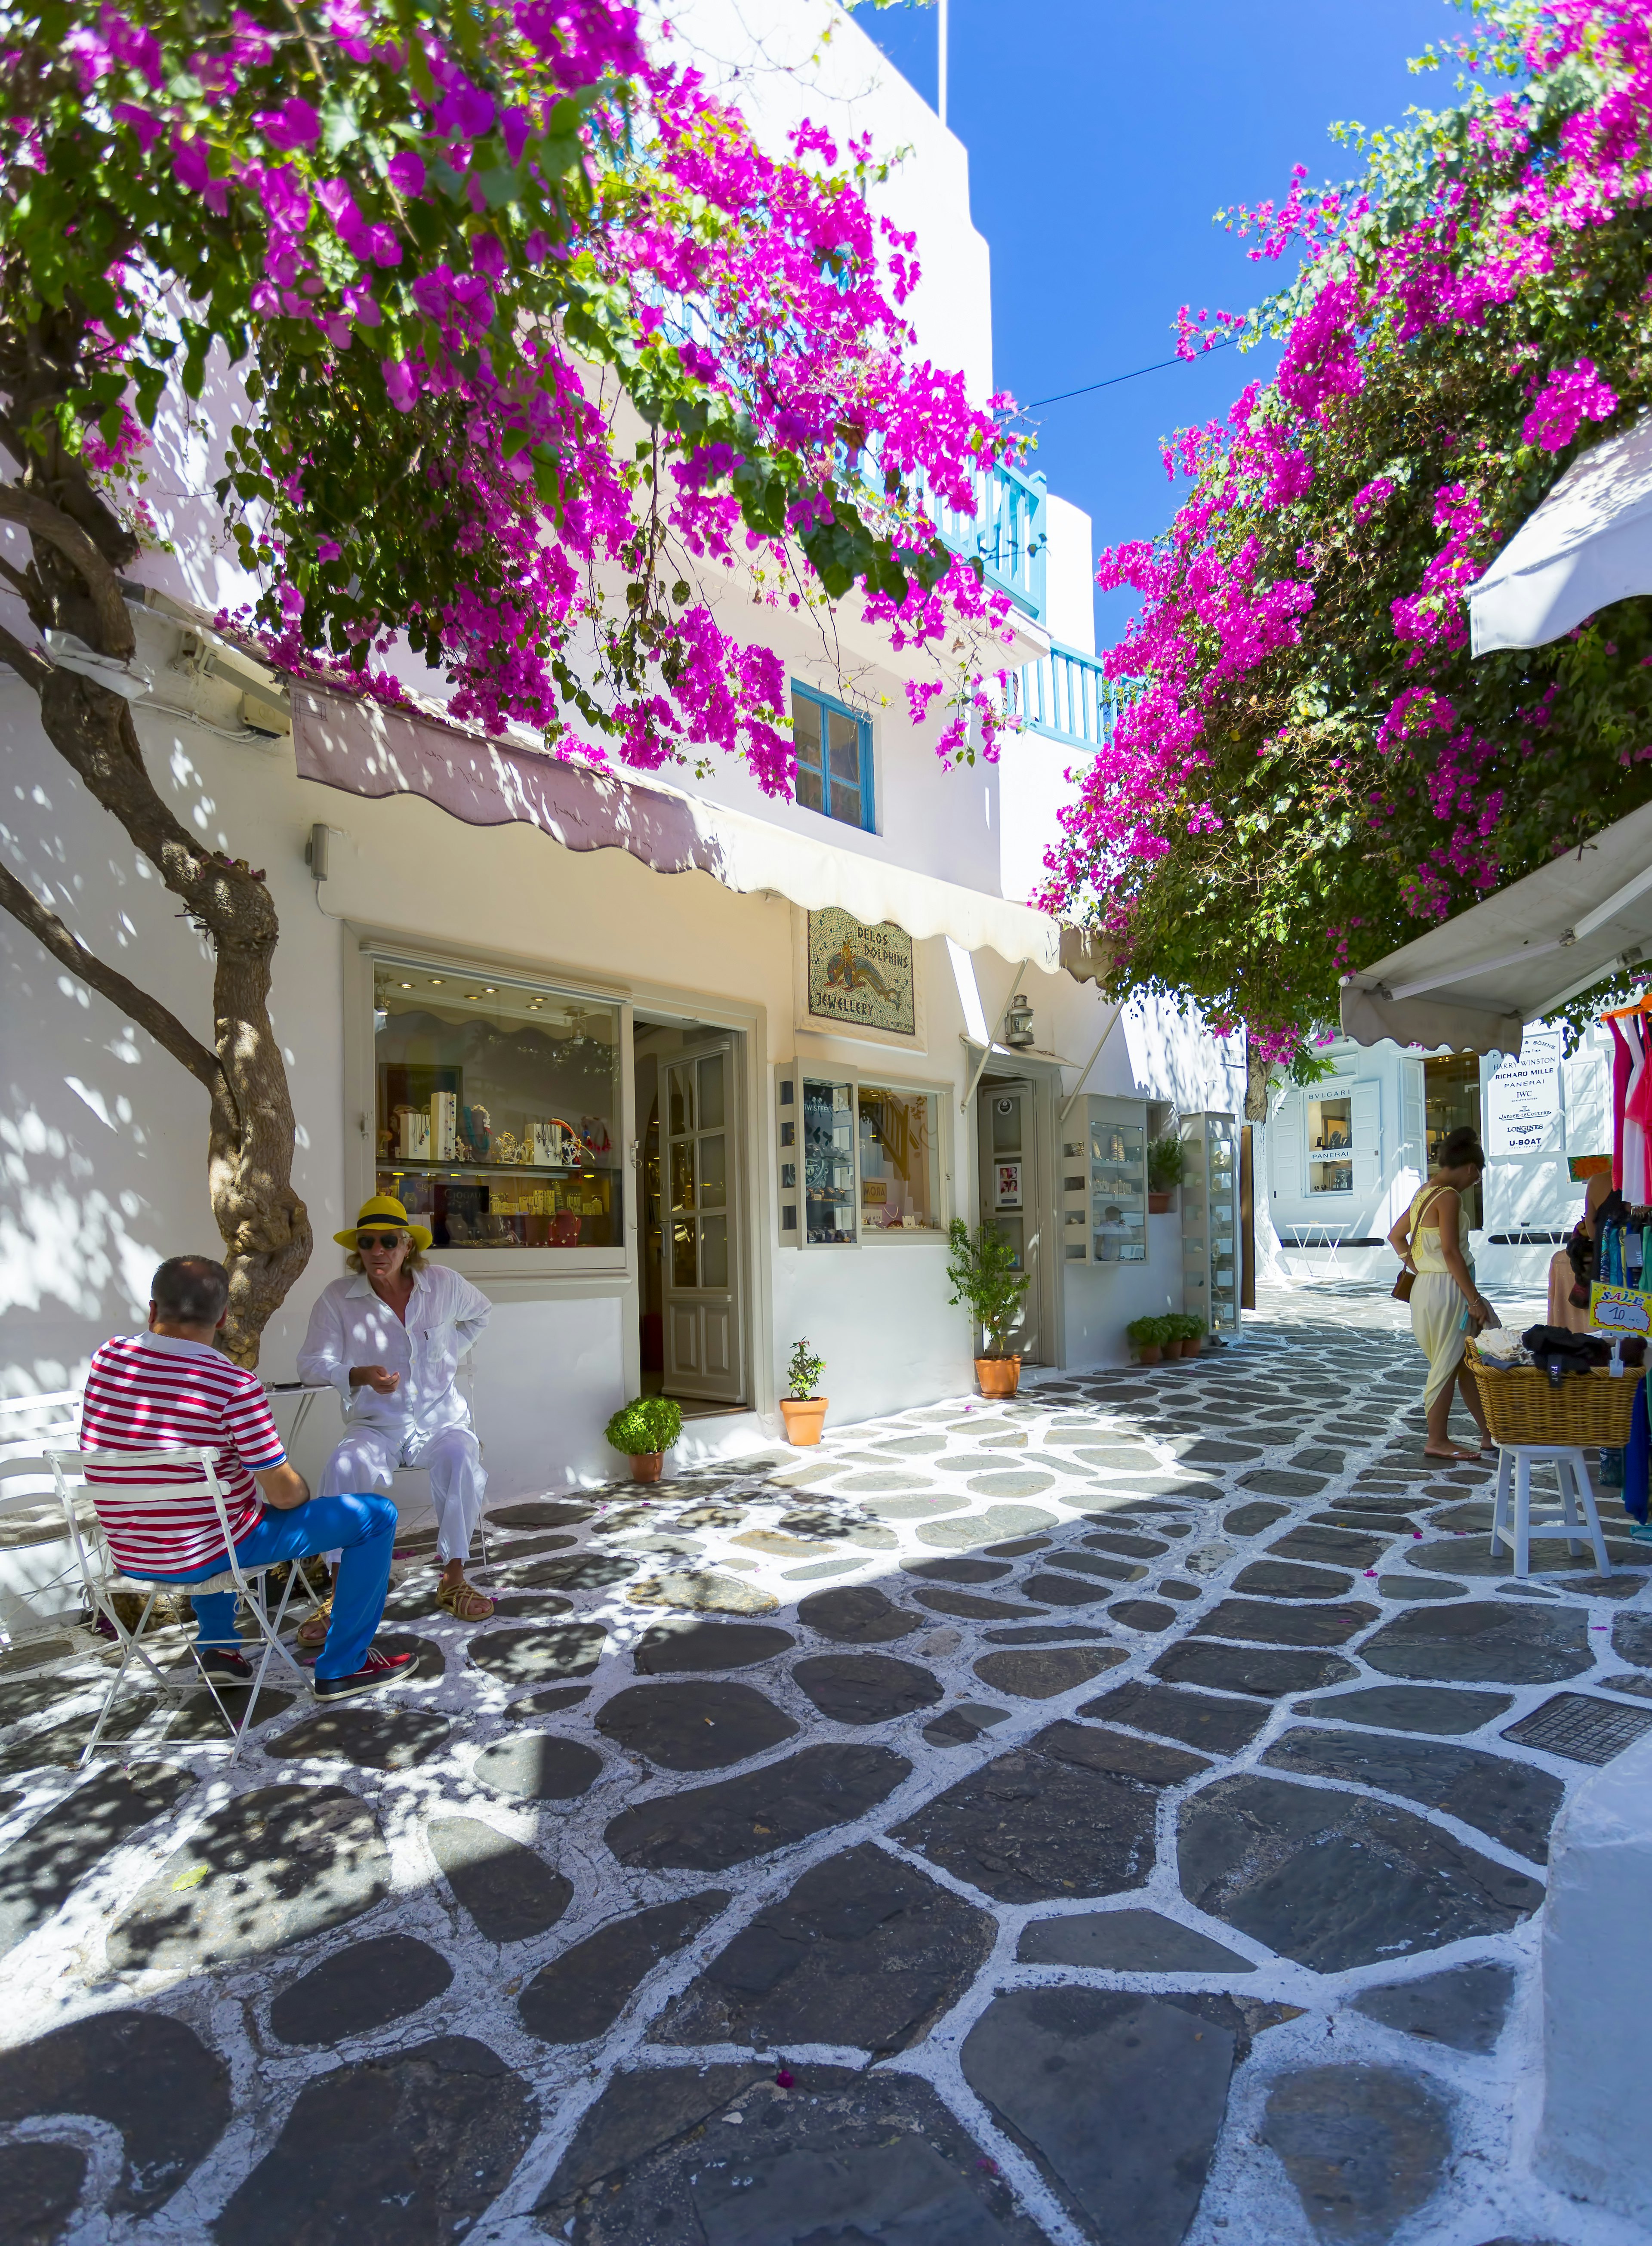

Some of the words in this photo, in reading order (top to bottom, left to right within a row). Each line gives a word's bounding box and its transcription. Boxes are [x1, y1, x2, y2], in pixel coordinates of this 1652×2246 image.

[858, 926, 888, 946] DELOS
[864, 944, 908, 969] DOLPHINS
[817, 992, 874, 1017] JEWELLERY
[1533, 1040, 1556, 1050] SÖHNE
[1493, 1062, 1517, 1071] HARRY
[1521, 1057, 1555, 1066] WINSTON
[1495, 1071, 1528, 1080] RICHARD
[1504, 1079, 1544, 1088] PANERAI
[1309, 1089, 1350, 1099] BVLGARI
[1507, 1124, 1543, 1132] LONGINES
[1601, 1291, 1644, 1306] SALE
[1609, 1307, 1625, 1320] 10
